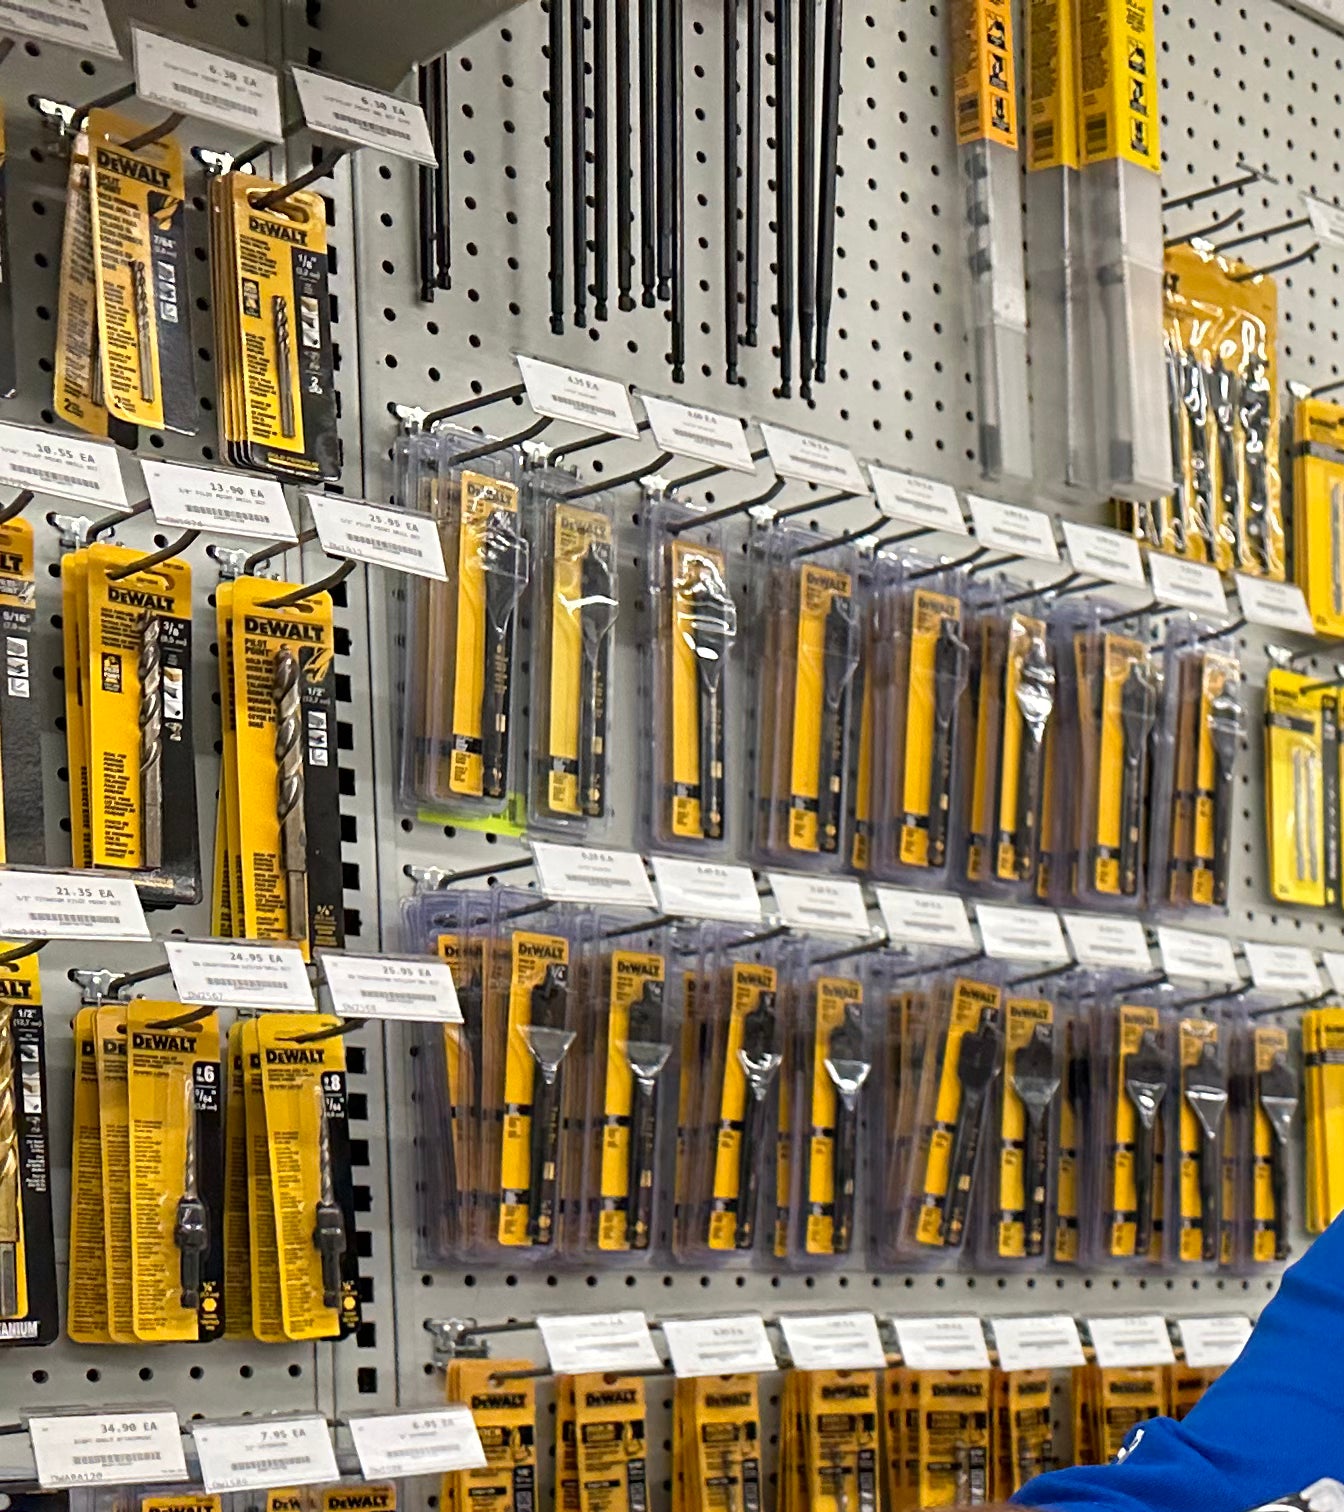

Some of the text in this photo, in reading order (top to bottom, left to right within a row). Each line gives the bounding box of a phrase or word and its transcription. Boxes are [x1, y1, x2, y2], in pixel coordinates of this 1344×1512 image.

[97, 151, 171, 191] DEWALT
[249, 215, 308, 247] DEWALT
[36, 443, 73, 459] 10.55
[108, 587, 175, 612] DEWALT
[244, 615, 325, 643] DEWALT
[518, 941, 564, 961] DEWALT
[132, 1033, 197, 1054] DEWALT
[266, 1049, 325, 1064] DEWALT
[328, 1493, 389, 1509] DEWALT
